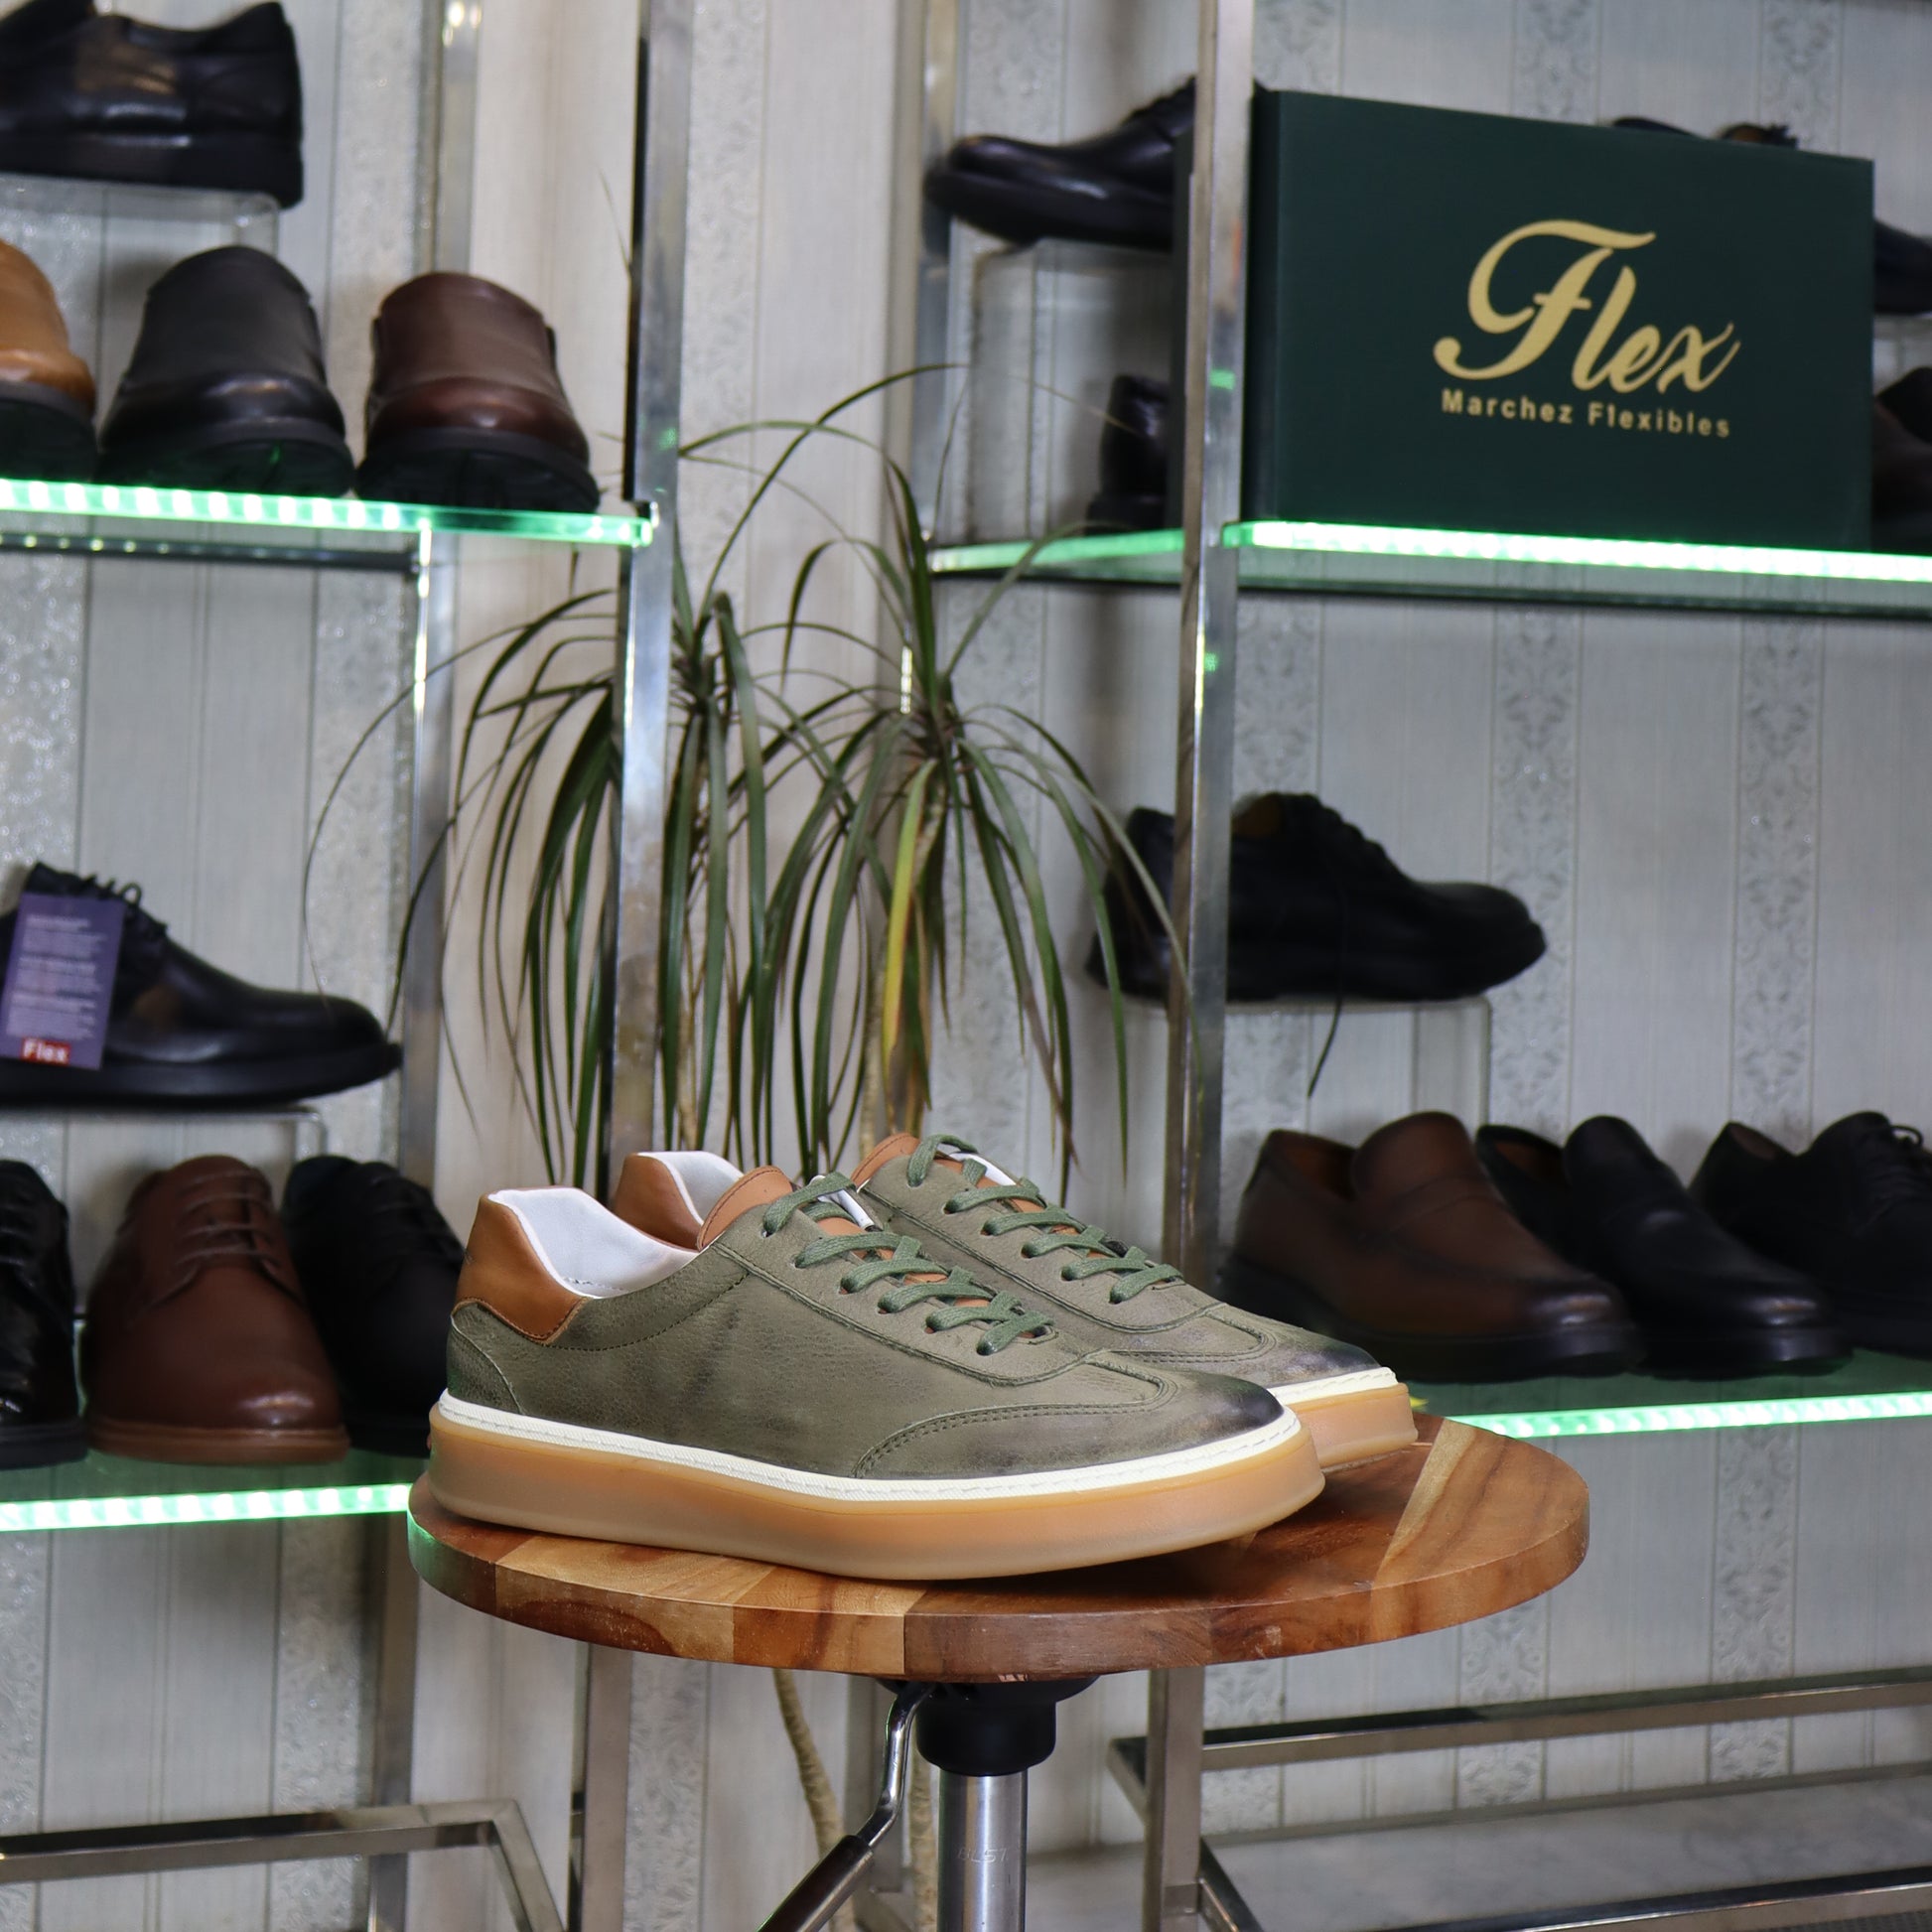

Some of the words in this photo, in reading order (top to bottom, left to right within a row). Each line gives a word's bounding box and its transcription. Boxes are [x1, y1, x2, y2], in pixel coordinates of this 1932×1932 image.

[1433, 218, 1740, 393] Flex
[1441, 387, 1574, 425] Marchez
[1587, 401, 1730, 438] Flexibles
